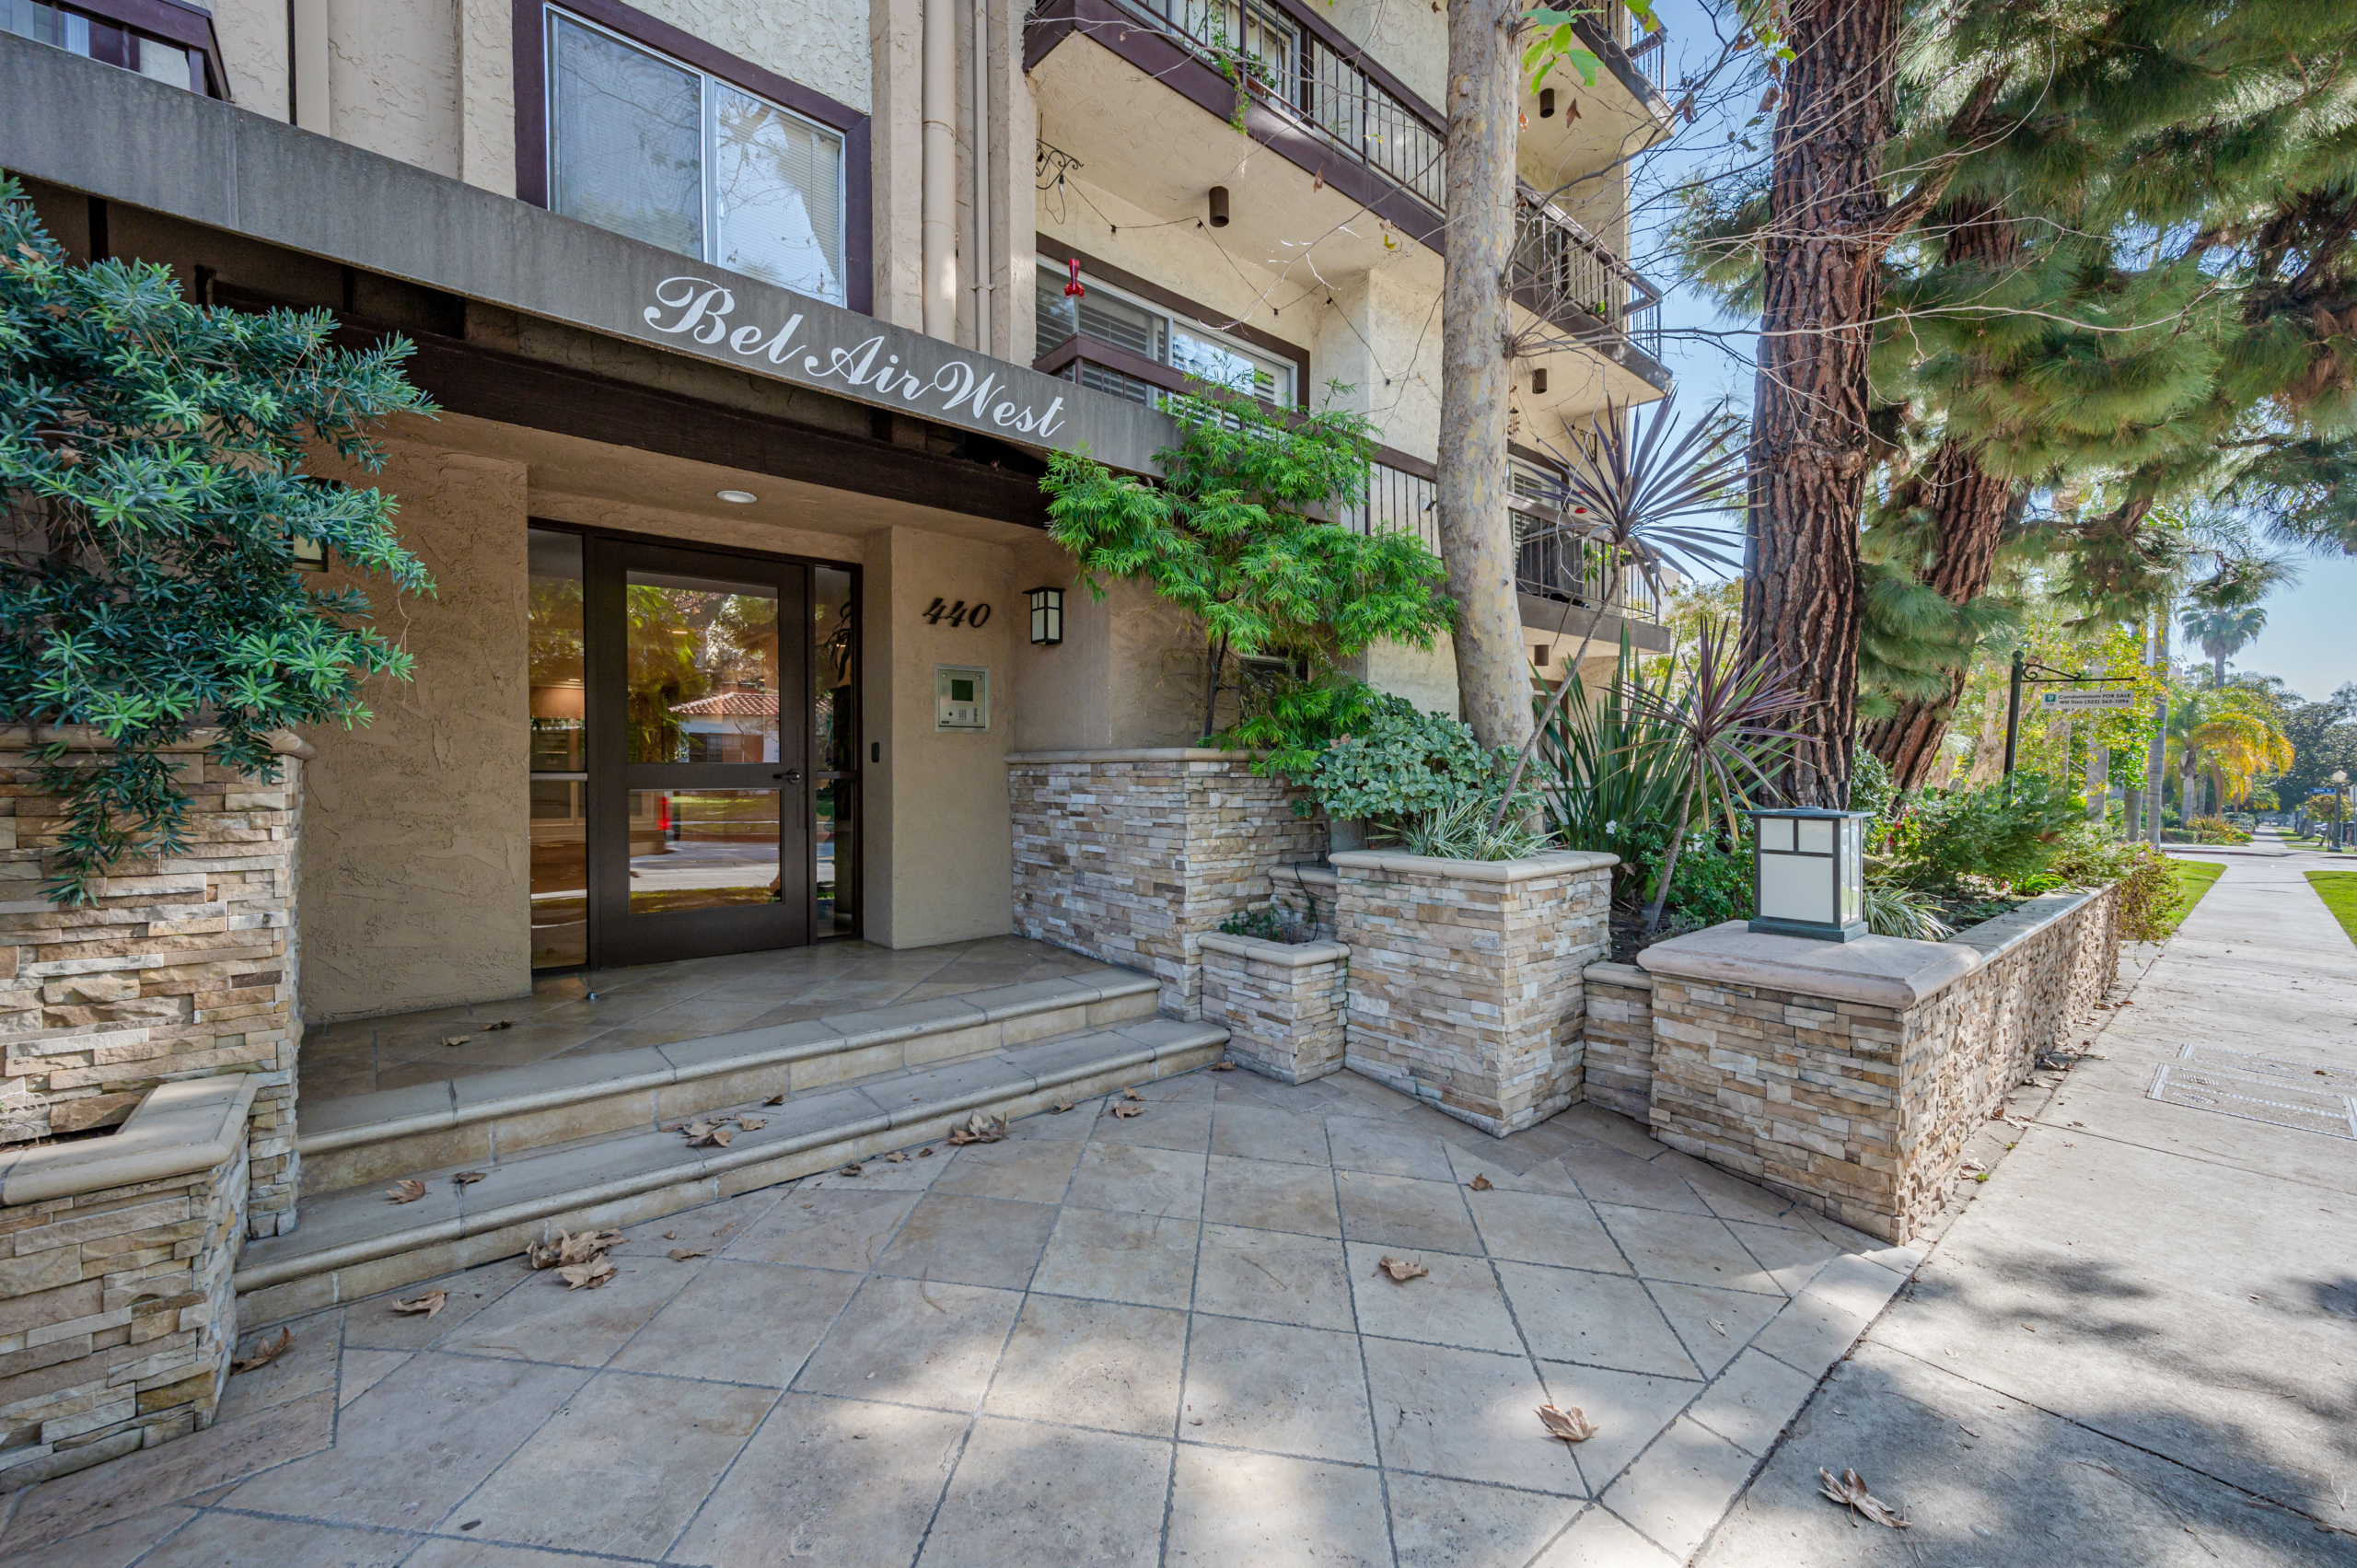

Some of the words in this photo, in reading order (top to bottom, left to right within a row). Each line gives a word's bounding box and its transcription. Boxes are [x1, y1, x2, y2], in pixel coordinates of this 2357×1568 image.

[644, 276, 807, 364] Bel
[805, 335, 935, 401] Air
[934, 361, 1065, 437] West
[923, 597, 991, 629] 440
